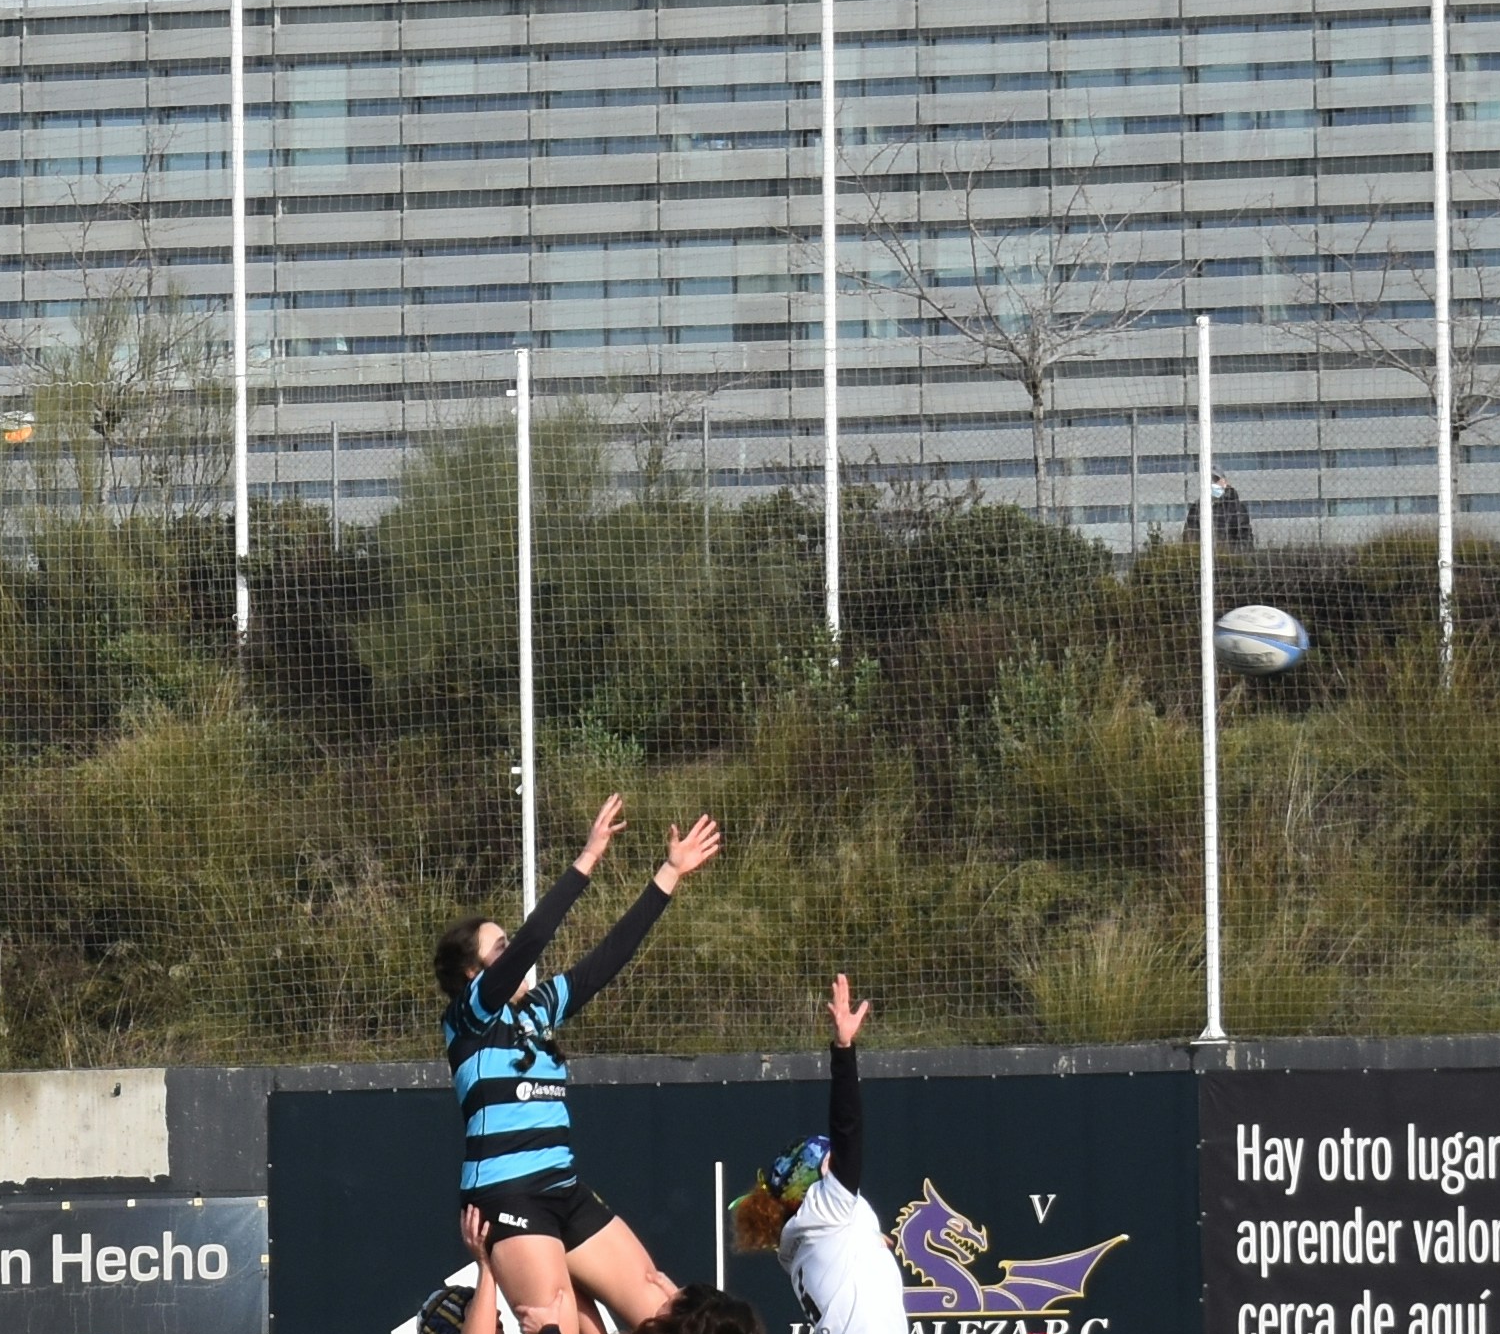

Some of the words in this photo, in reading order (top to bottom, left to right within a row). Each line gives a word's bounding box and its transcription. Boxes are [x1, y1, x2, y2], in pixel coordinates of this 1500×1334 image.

[1237, 1124, 1304, 1195] Hay
[1317, 1127, 1392, 1181] otro
[498, 1212, 528, 1229] BLK
[1029, 1194, 1056, 1224] V
[52, 1231, 228, 1283] Hecho
[1236, 1206, 1402, 1278] aprender
